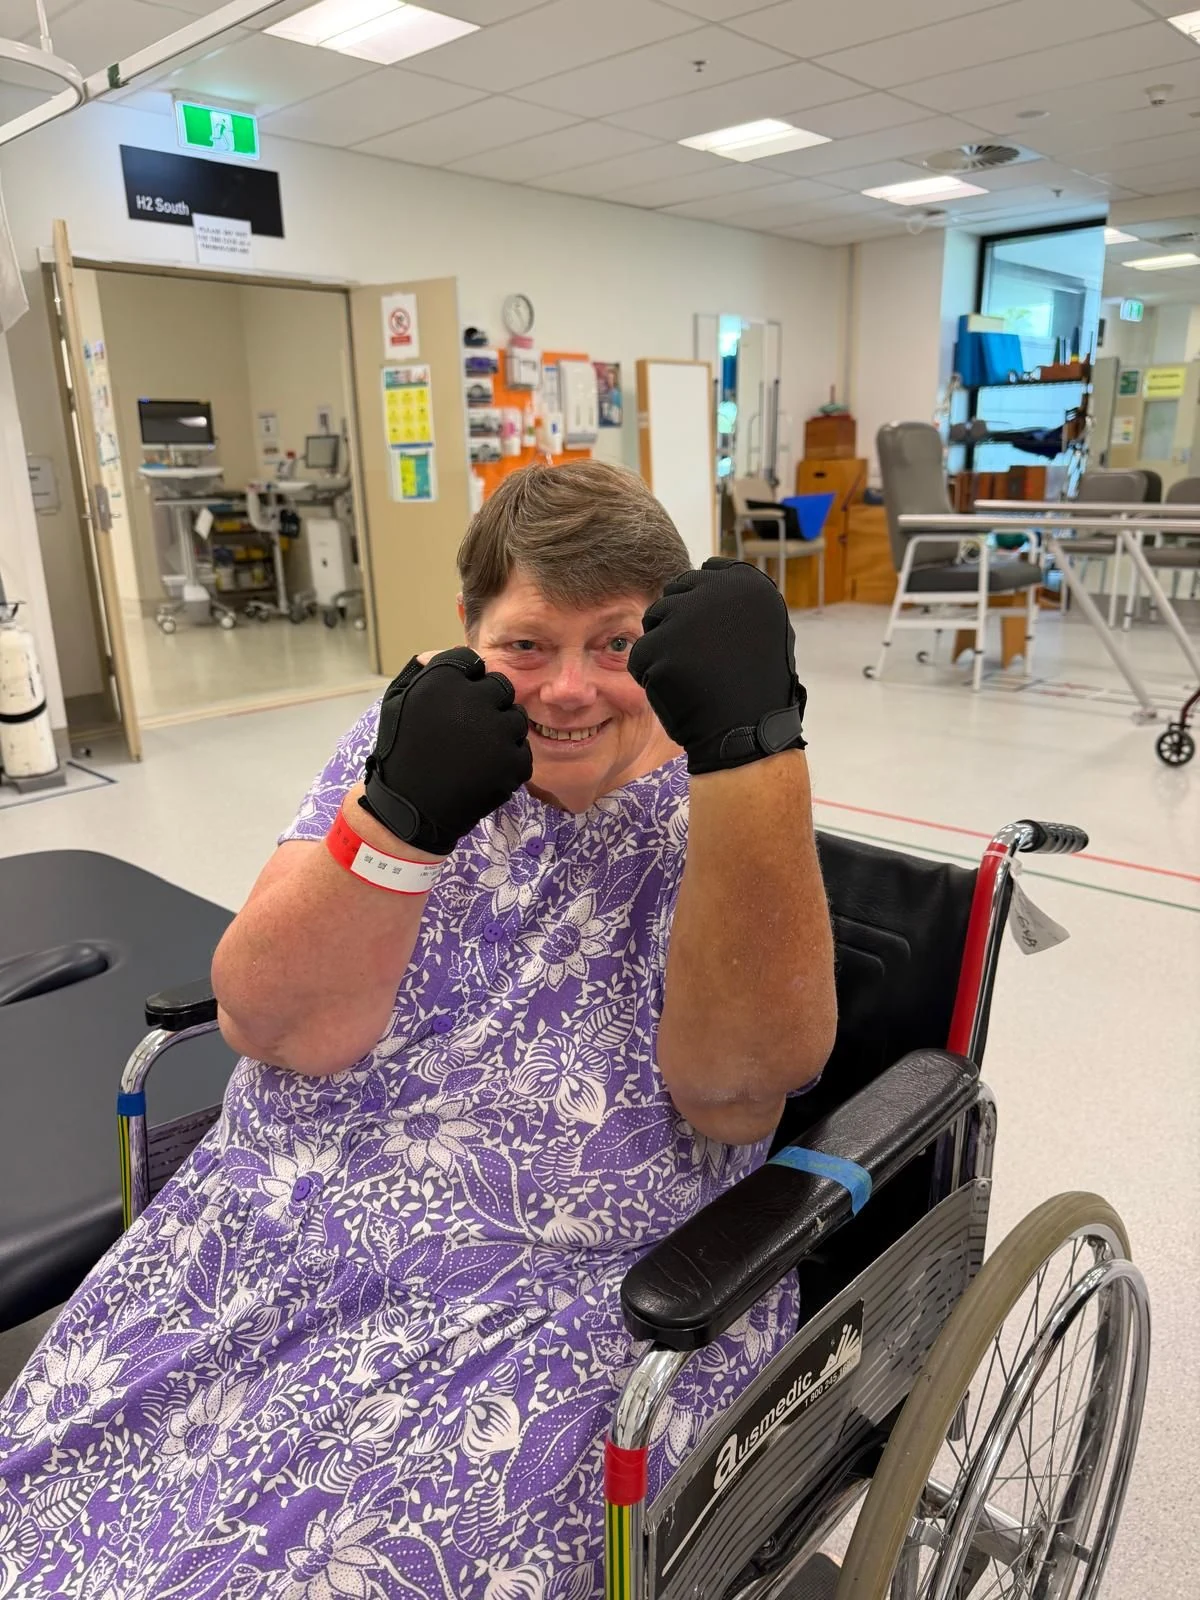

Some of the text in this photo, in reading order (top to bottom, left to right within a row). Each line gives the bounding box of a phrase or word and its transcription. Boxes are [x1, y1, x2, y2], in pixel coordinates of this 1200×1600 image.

[136, 194, 190, 217] H2 South
[810, 1384, 824, 1402] 800
